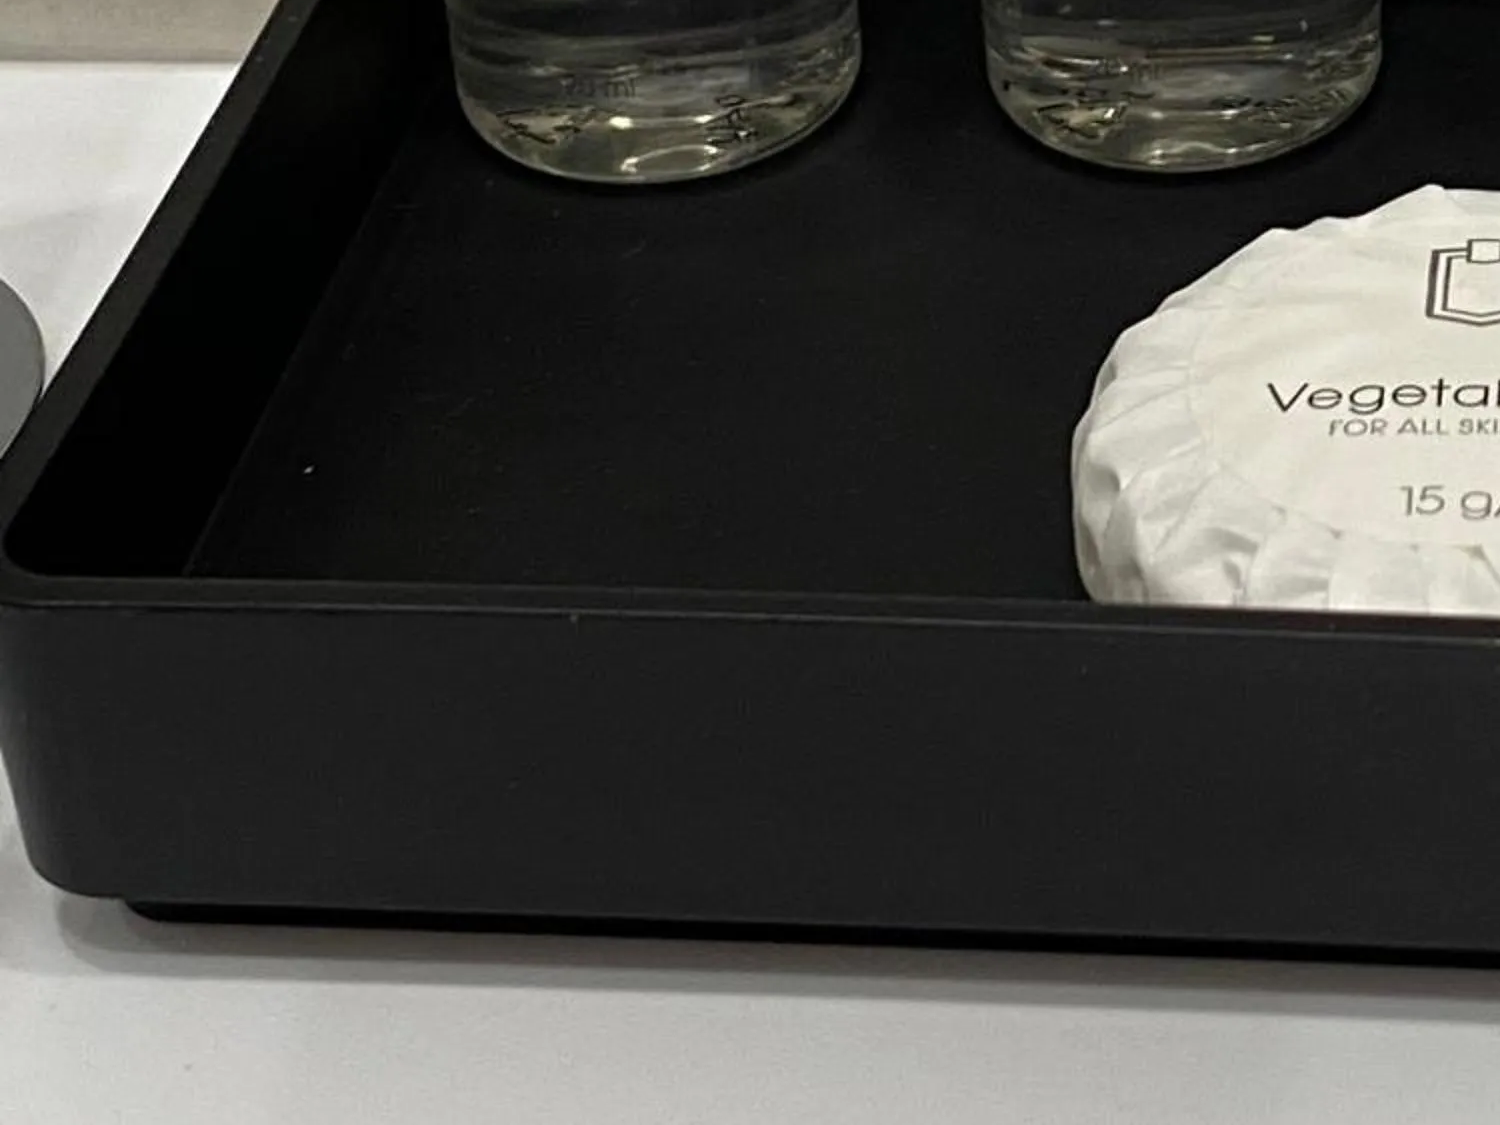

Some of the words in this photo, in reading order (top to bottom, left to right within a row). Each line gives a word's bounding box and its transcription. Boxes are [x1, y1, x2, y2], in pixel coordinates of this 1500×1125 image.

[1329, 418, 1389, 438] FOR
[1398, 418, 1449, 436] ALL
[1400, 485, 1446, 517] 15
